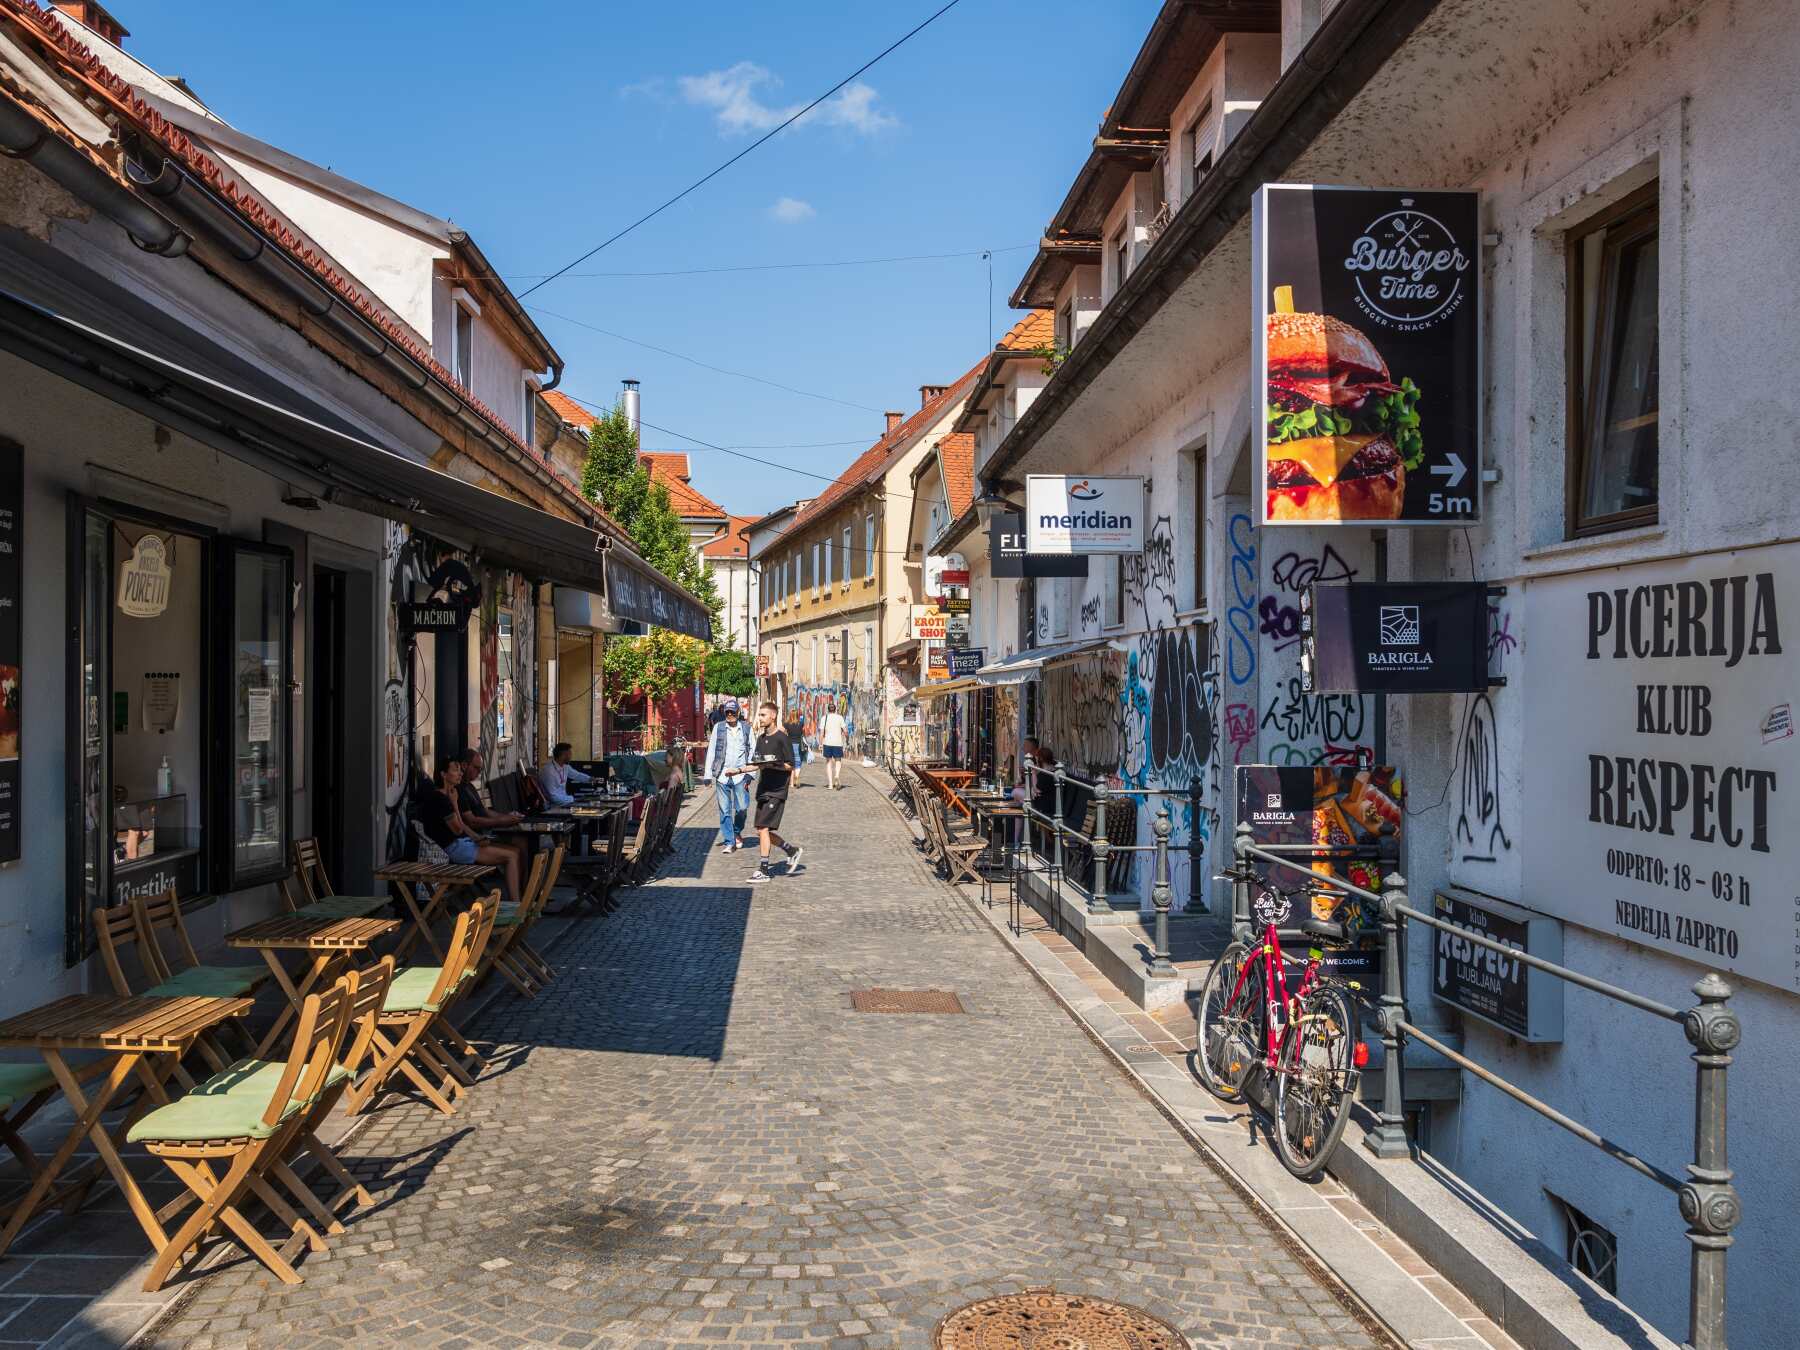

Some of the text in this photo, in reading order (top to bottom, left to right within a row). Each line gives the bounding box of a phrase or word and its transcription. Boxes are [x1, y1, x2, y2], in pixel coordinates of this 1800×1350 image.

[1344, 236, 1470, 281] Burger
[1380, 275, 1439, 299] Time
[1354, 294, 1464, 331] BURGER SNACK DRINK
[1040, 511, 1132, 529] meridian
[125, 570, 166, 605] PORETTI
[1586, 572, 1783, 668] PICERIJA
[952, 659, 980, 668] meze
[1368, 652, 1434, 664] BARIGLA
[1636, 684, 1712, 737] KLUB
[1253, 812, 1296, 820] BARIGLA
[1588, 754, 1777, 853] RESPECT
[1606, 848, 1669, 887] ODPRTO:
[1673, 862, 1691, 892] 18
[1711, 870, 1733, 902] 03
[1739, 875, 1751, 907] h
[1470, 904, 1488, 929] klub
[1615, 899, 1739, 960] NEDELJA ZAPRTO
[1439, 915, 1524, 985] RESPECT
[1456, 962, 1502, 996] LJUBLJANA
